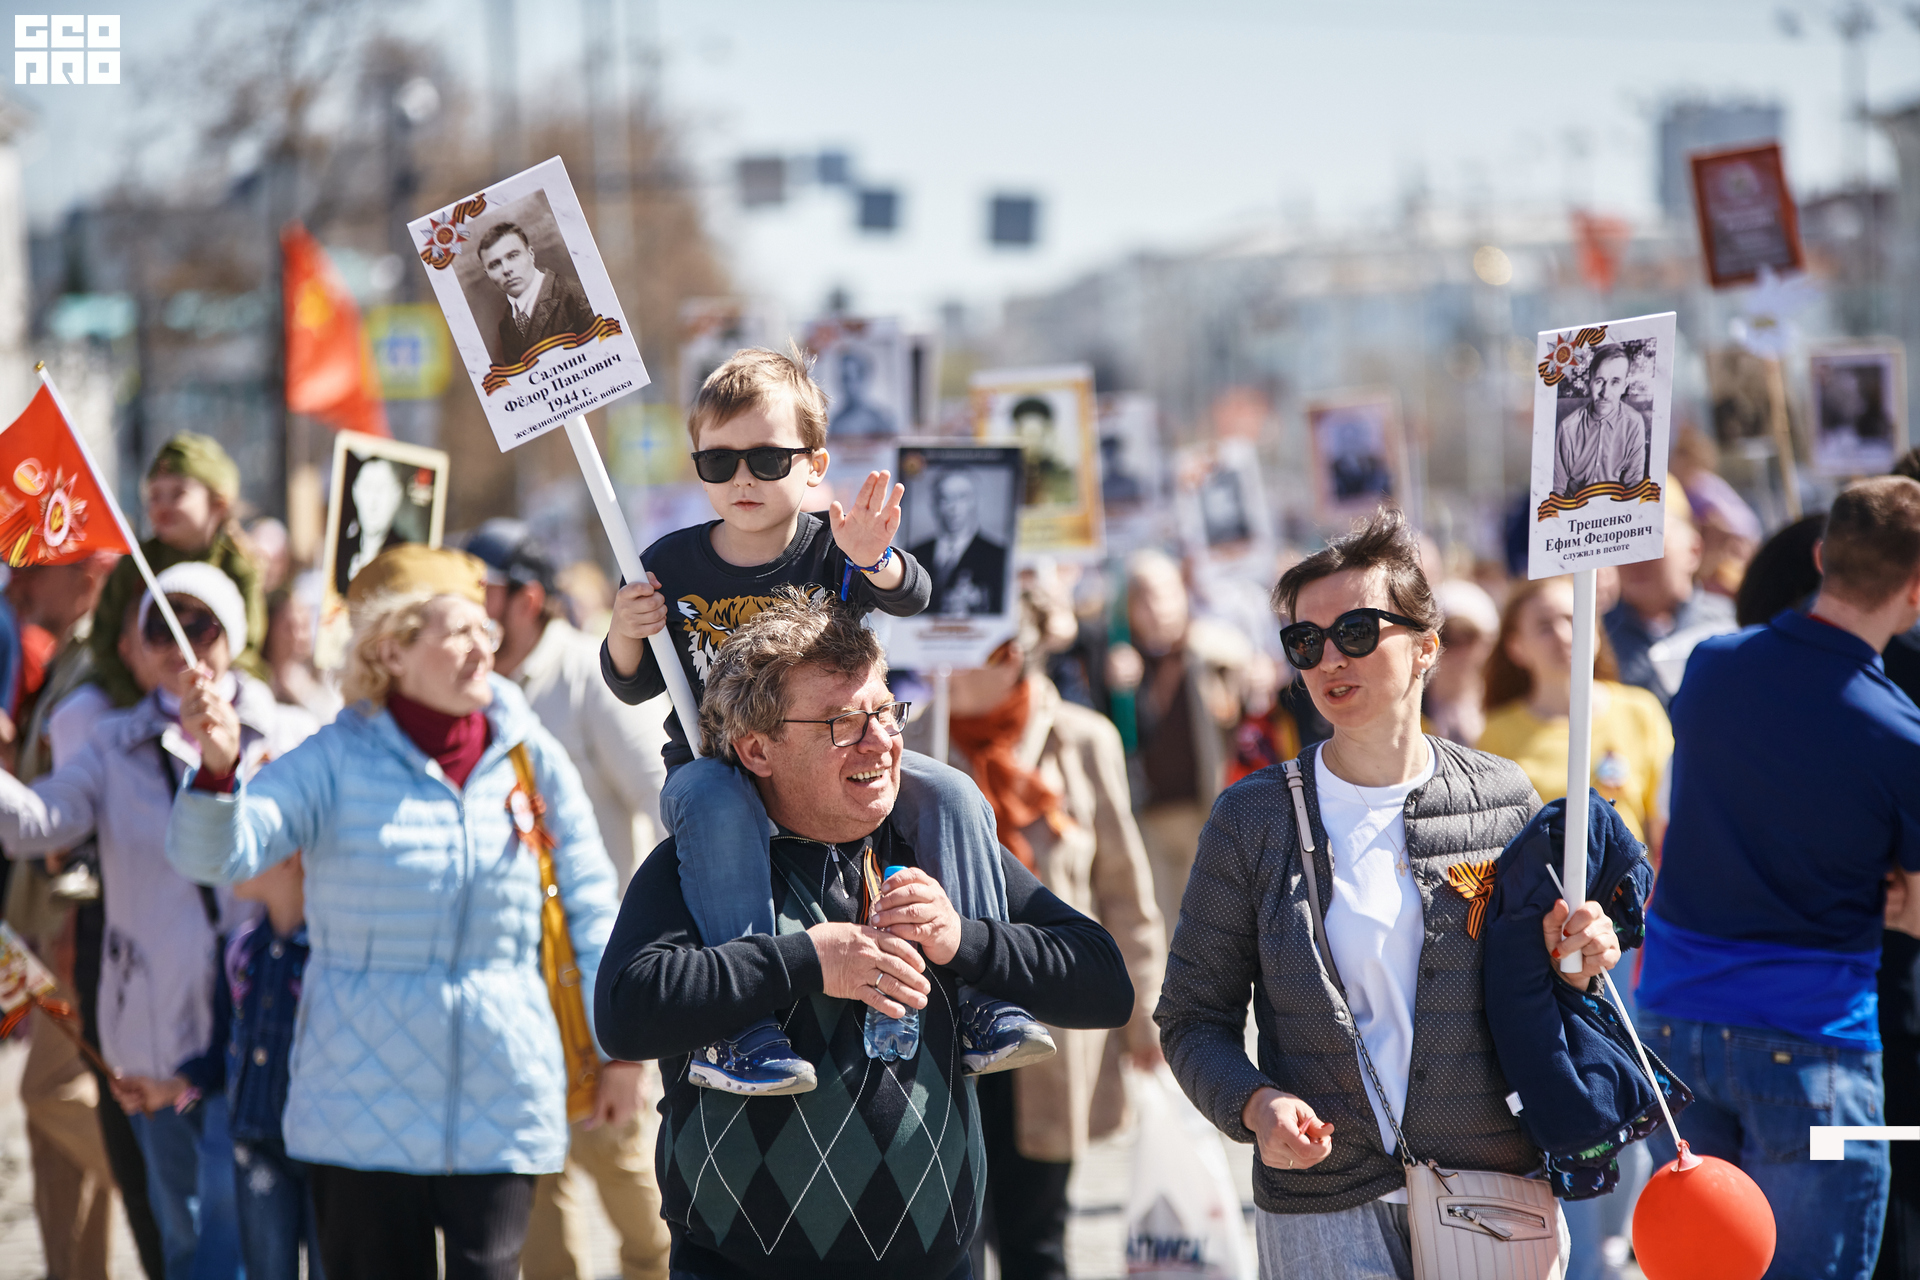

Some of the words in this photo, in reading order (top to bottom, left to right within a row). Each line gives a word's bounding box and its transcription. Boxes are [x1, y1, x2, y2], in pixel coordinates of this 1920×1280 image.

[504, 388, 549, 412] Фёдор
[551, 353, 621, 392] Павлович
[528, 353, 587, 385] Салмин
[514, 395, 599, 439] железнодорожные
[601, 379, 633, 399] войска
[547, 389, 579, 413] 1944
[582, 386, 592, 397] г.
[1567, 513, 1632, 535] Трещенко
[1545, 538, 1581, 553] Ефим
[1584, 526, 1652, 545] Федорович
[1563, 549, 1594, 561] служил
[1603, 543, 1630, 554] пехоте
